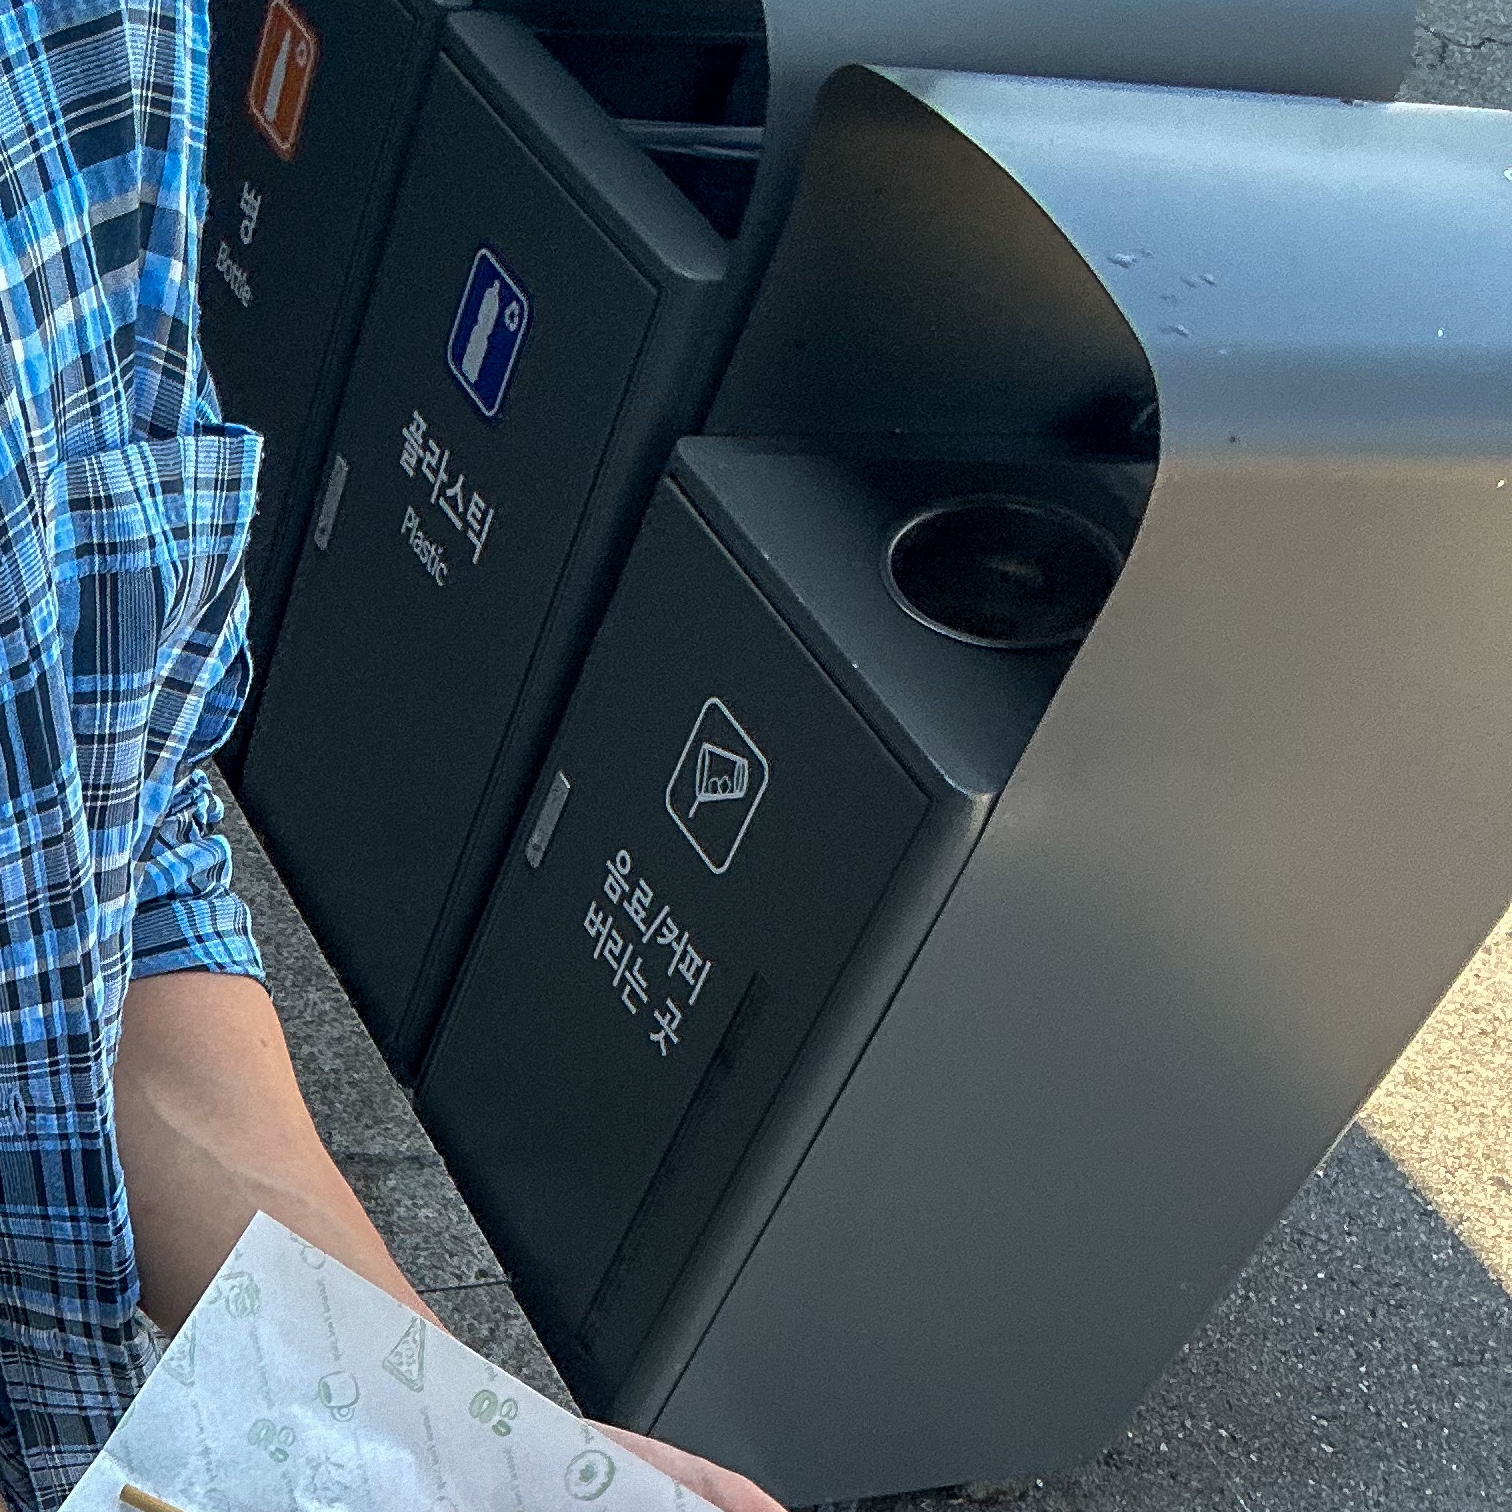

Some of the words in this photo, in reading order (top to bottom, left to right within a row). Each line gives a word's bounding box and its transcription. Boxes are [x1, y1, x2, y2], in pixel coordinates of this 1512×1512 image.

[239, 181, 262, 244] 병
[216, 241, 253, 308] Bottle
[400, 410, 494, 565] 플라스틱
[401, 505, 449, 587] Plastic
[583, 901, 648, 1014] 버리는
[649, 998, 683, 1057] 곳
